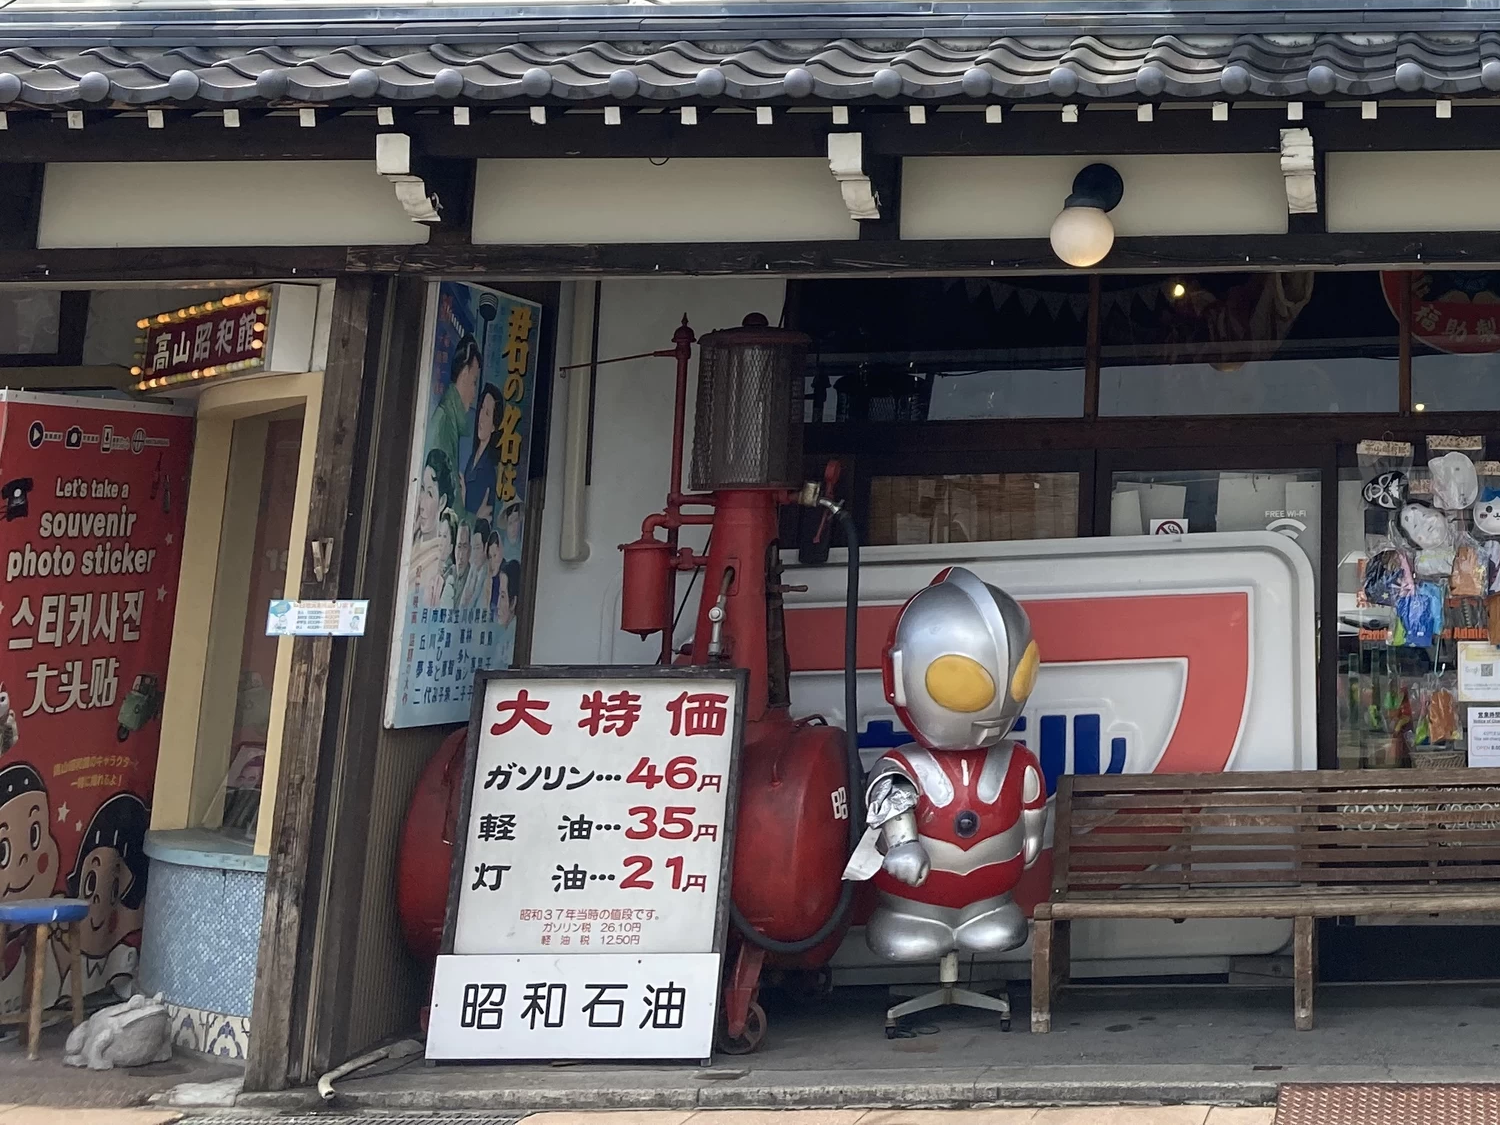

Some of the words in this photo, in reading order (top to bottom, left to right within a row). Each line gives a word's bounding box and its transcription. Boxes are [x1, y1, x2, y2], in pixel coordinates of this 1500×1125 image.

[152, 313, 257, 372] 高山昭和館
[56, 478, 87, 498] Let's
[91, 479, 118, 498] take
[121, 484, 129, 498] a
[39, 505, 137, 538] souvenir
[1265, 510, 1285, 518] FREE
[7, 543, 76, 581] photo
[81, 542, 156, 575] sticker
[8, 590, 145, 650] 스티커사진
[22, 658, 120, 717] 大头贴
[490, 689, 729, 737] 大特価
[542, 922, 591, 933] ガソリン税
[600, 922, 642, 933] 26.10円
[461, 981, 686, 1030] 昭和石油
